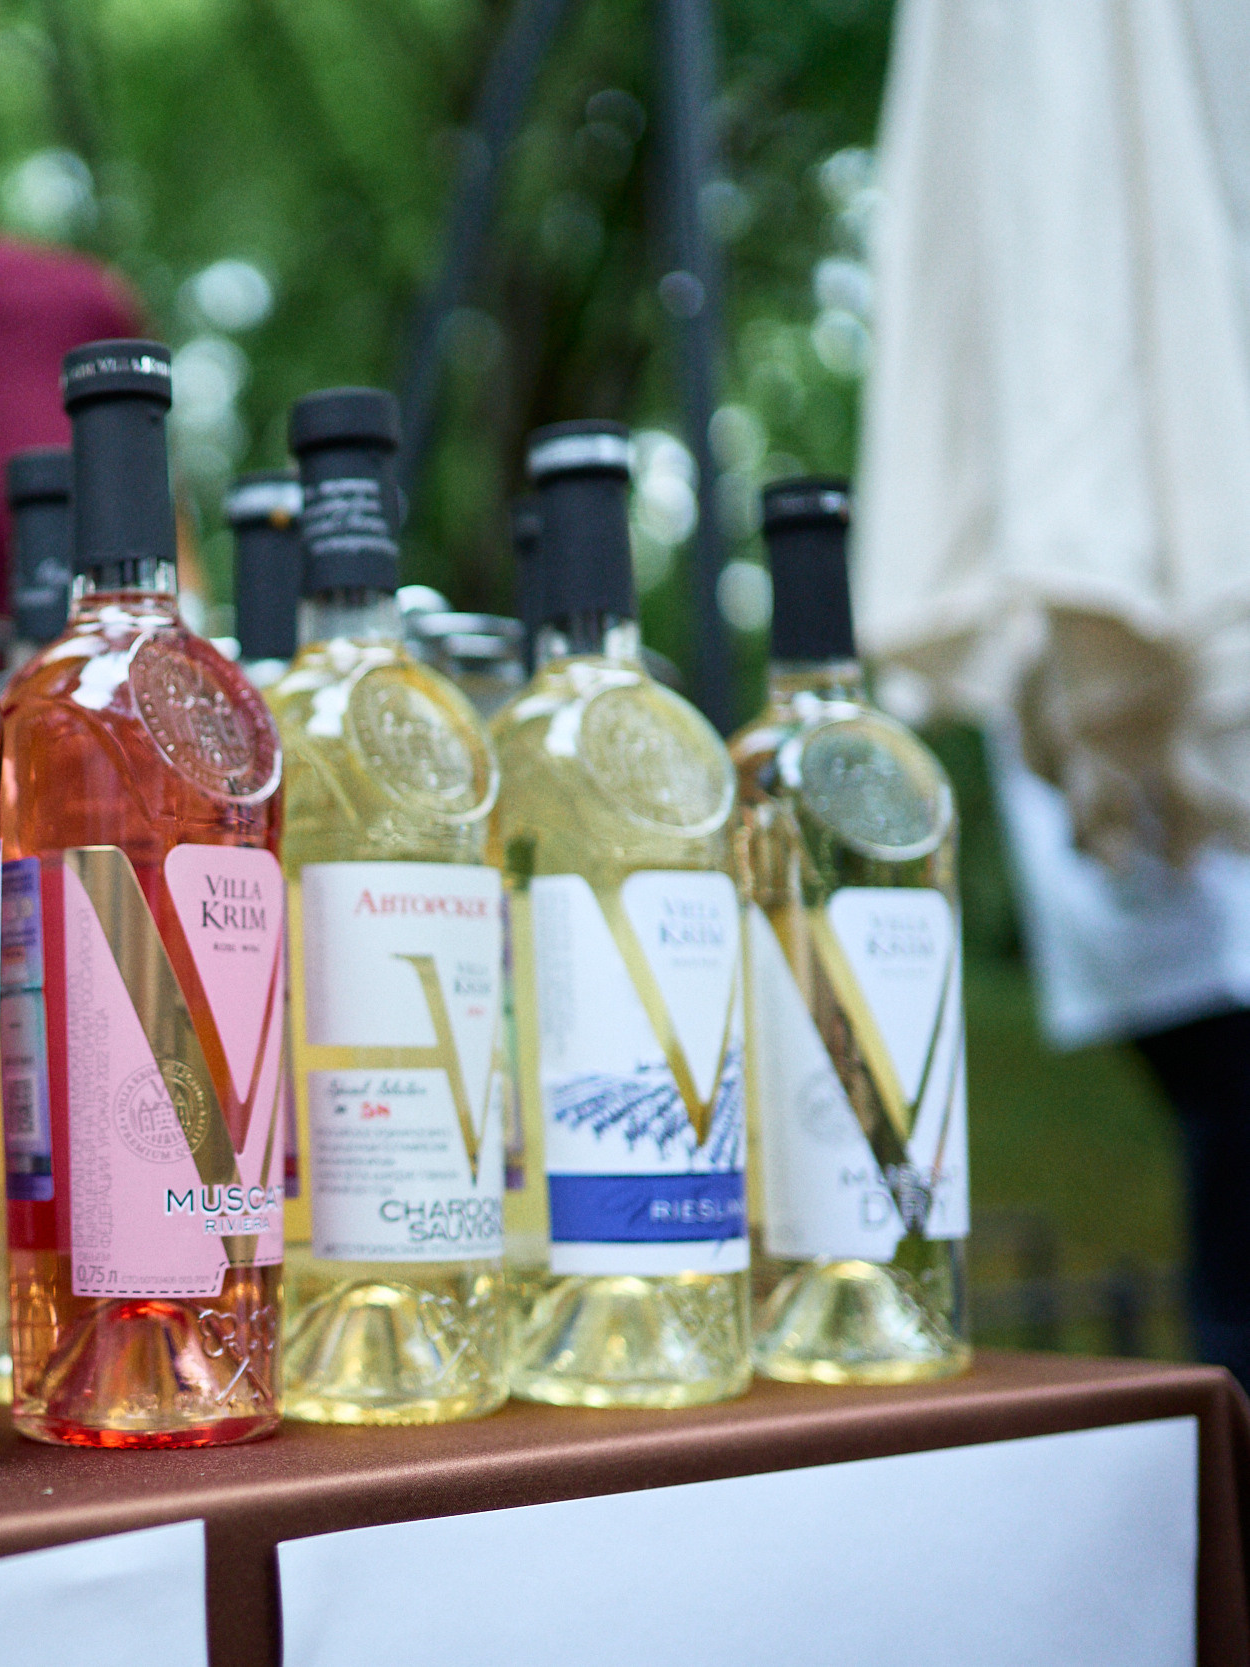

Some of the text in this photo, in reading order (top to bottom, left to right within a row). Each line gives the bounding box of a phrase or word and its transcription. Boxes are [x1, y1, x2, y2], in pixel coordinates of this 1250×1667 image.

[205, 874, 261, 900] VILLA
[202, 901, 266, 931] KRIM
[205, 1217, 270, 1233] RIVIERA
[77, 1264, 105, 1285] 0,75
